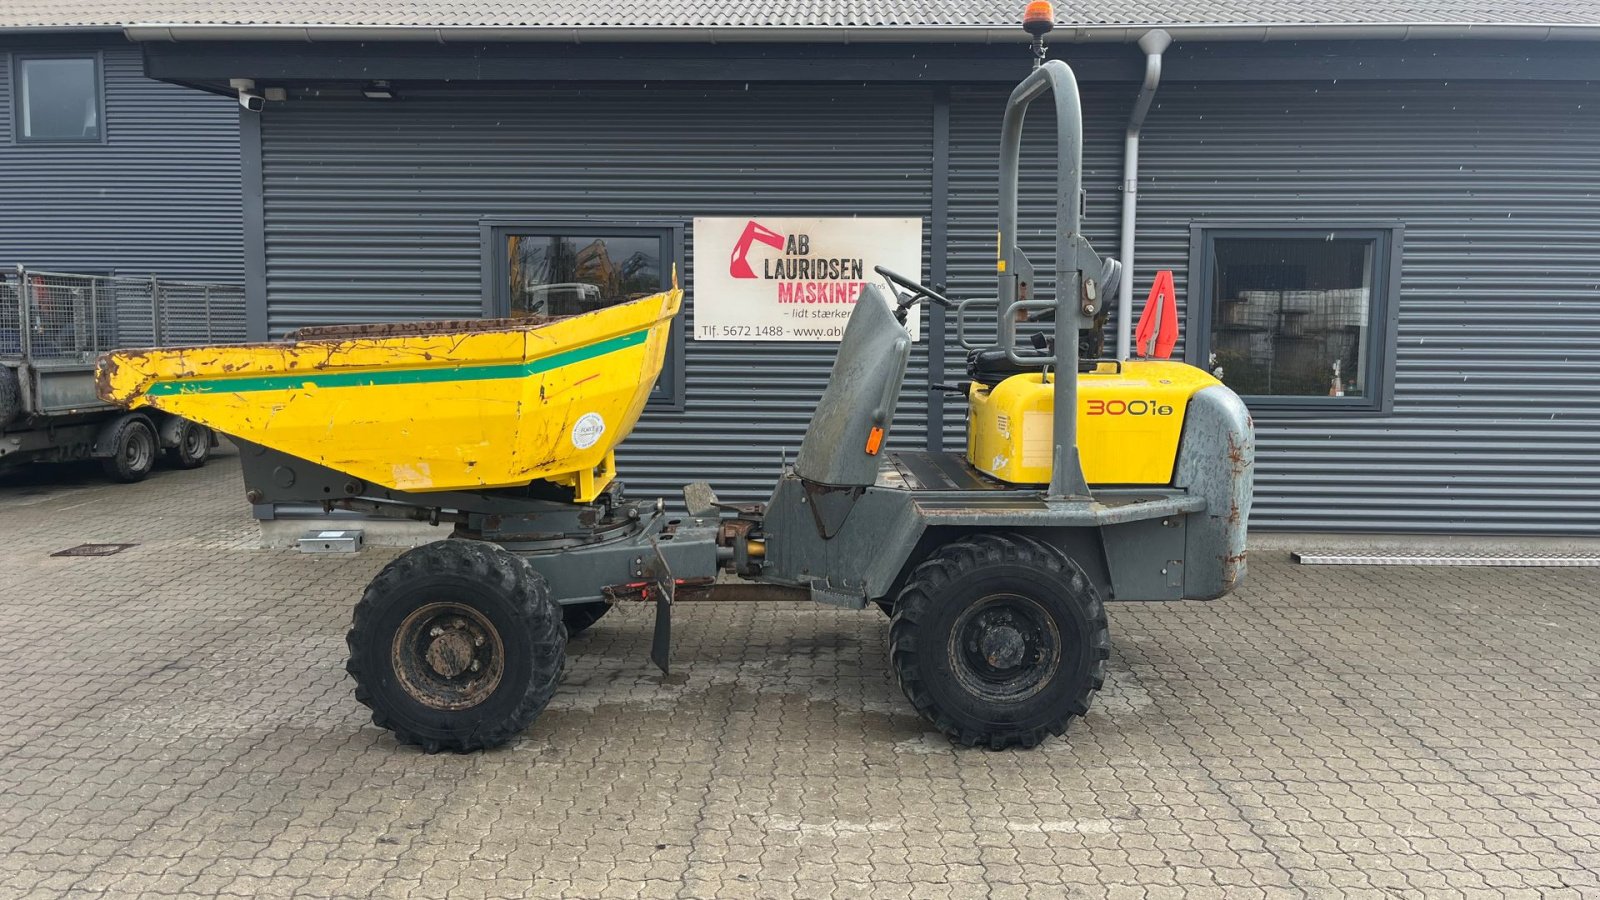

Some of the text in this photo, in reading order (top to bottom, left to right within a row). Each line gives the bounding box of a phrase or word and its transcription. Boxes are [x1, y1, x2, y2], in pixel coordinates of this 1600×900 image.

[786, 234, 810, 256] AB
[764, 258, 863, 280] LAURIDSEN
[792, 309, 808, 318] lidt
[702, 325, 720, 338] Tlf.
[723, 325, 751, 336] 5672
[755, 325, 783, 336] 1488
